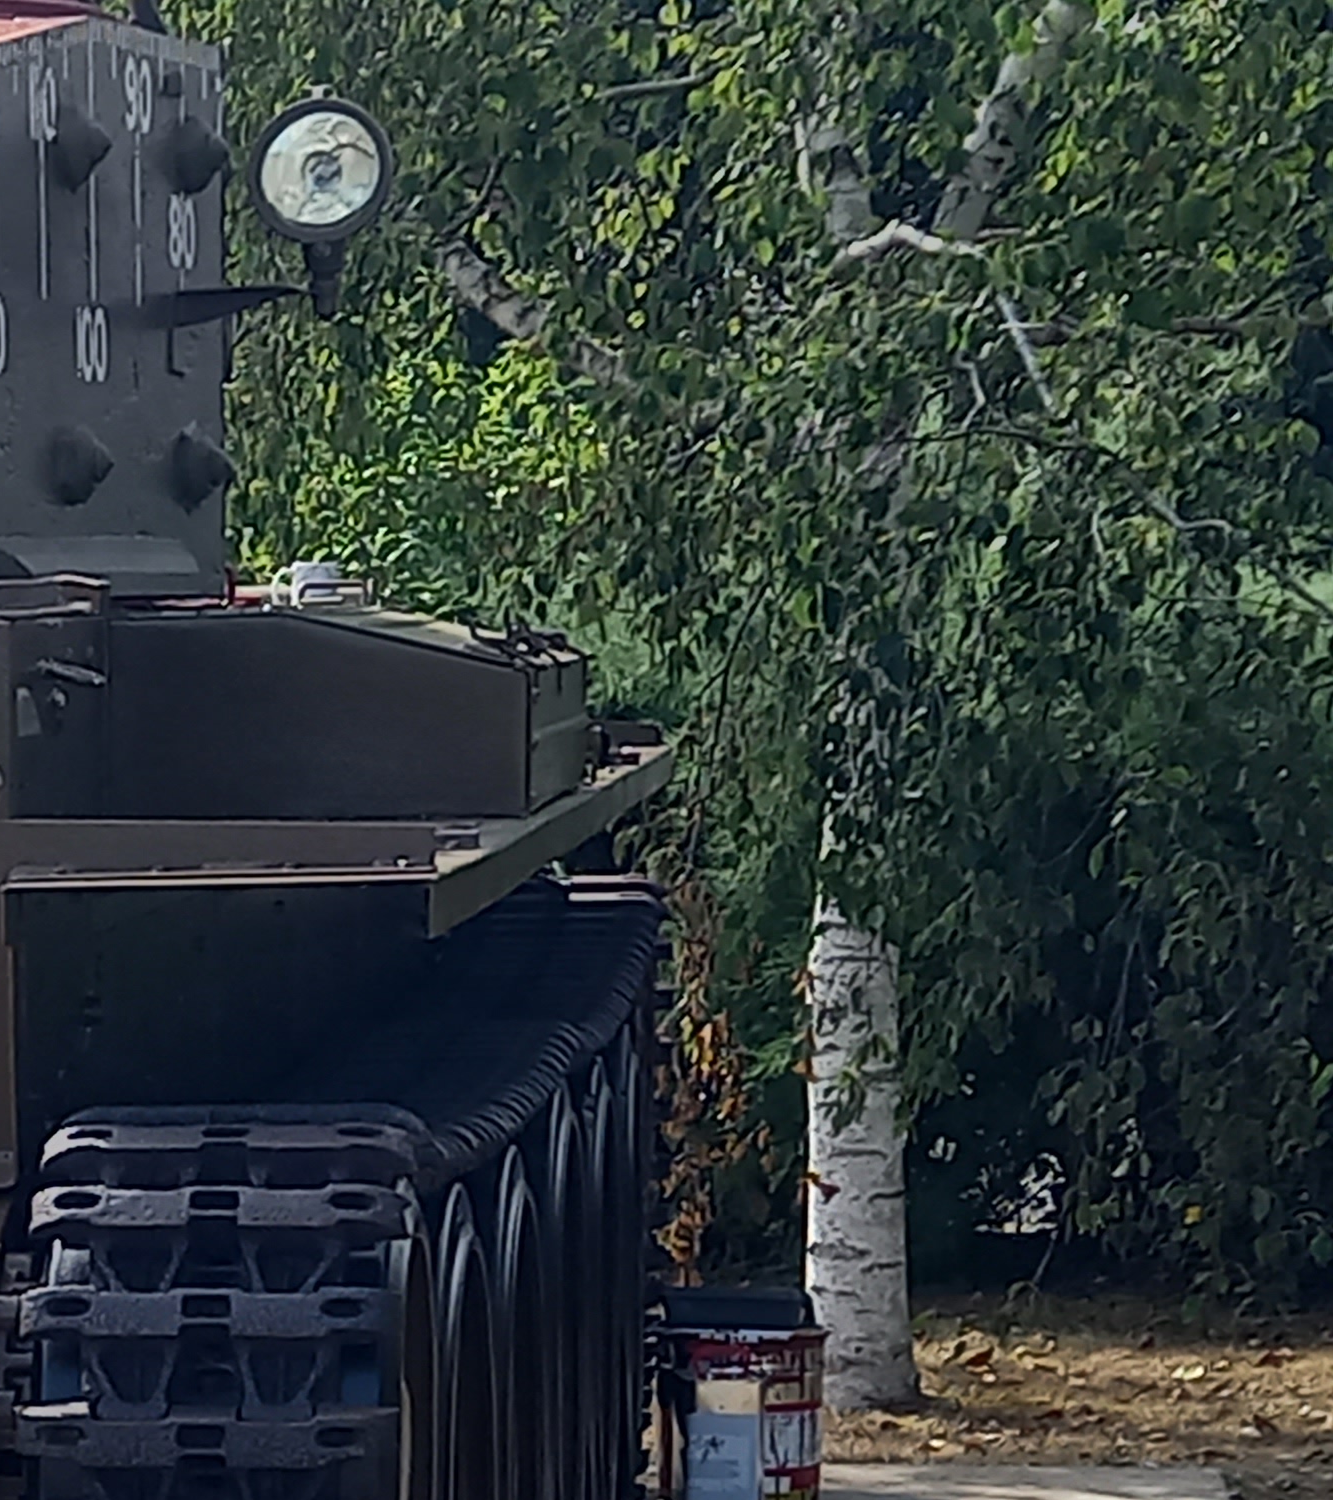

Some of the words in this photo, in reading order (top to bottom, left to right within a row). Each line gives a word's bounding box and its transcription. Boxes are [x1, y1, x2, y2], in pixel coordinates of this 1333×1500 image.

[125, 55, 151, 133] 90
[169, 194, 196, 270] 80
[76, 305, 107, 382] 100
